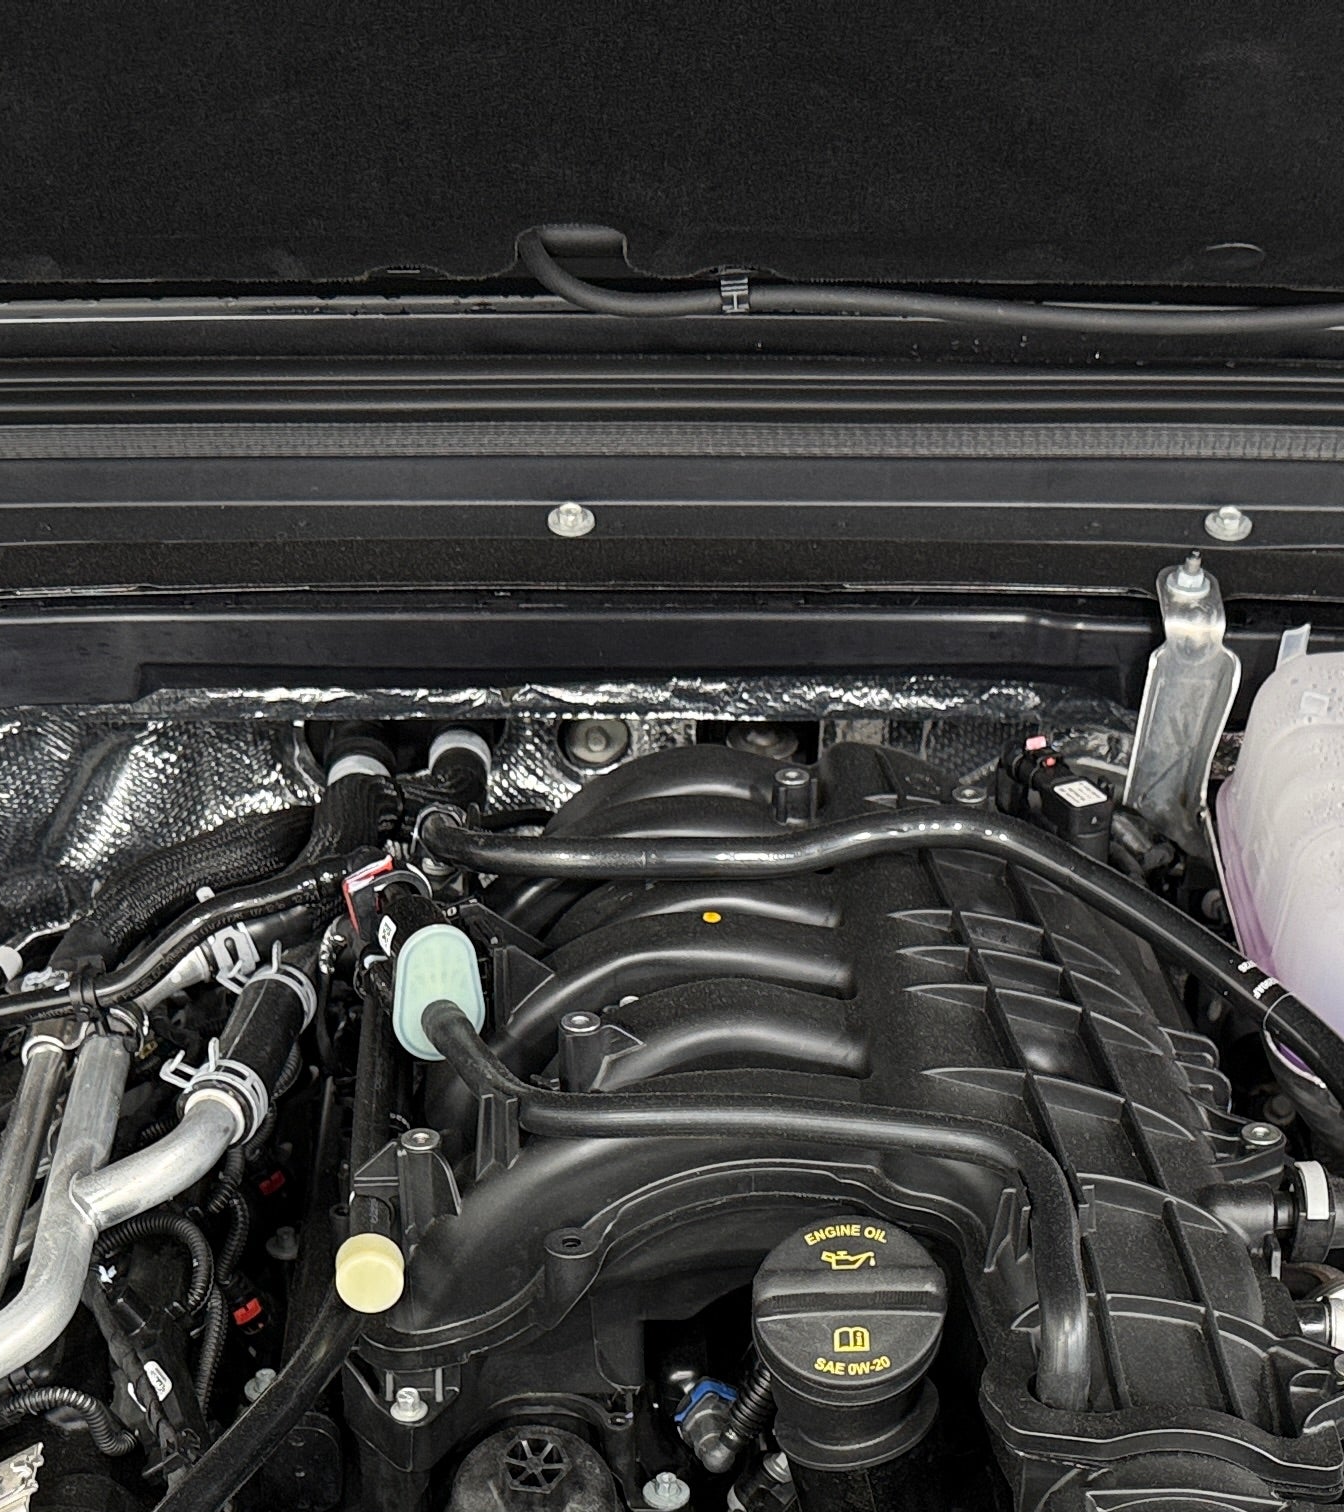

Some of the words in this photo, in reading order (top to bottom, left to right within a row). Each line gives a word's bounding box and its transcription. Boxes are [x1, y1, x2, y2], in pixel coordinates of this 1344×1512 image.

[804, 1224, 861, 1246] ENGINE
[864, 1227, 888, 1243] OIL
[814, 1357, 845, 1375] SAE
[848, 1356, 891, 1376] 0W-20
